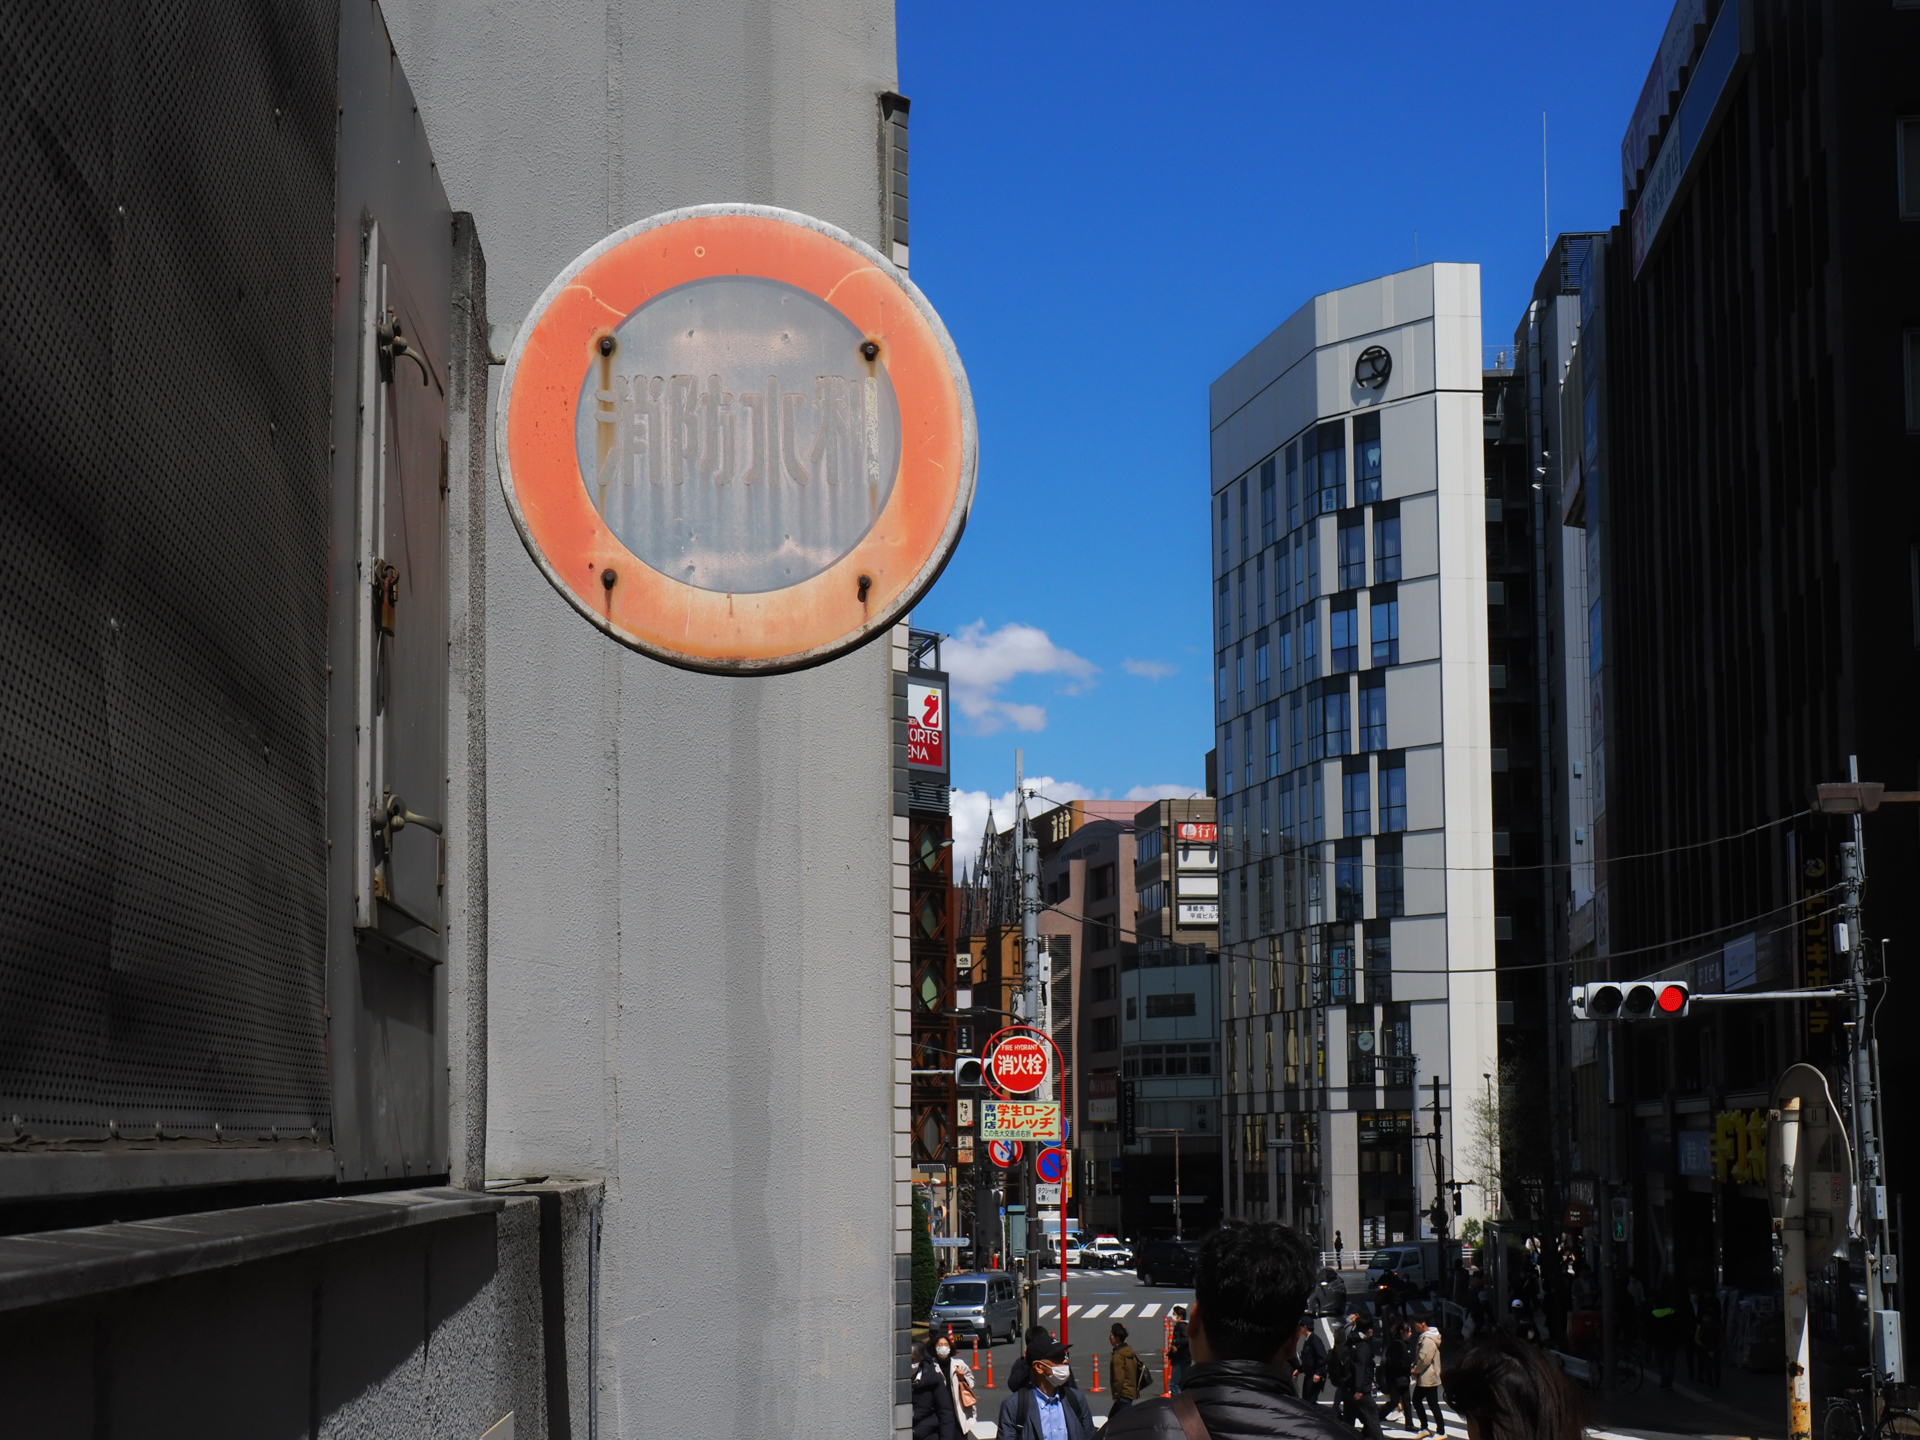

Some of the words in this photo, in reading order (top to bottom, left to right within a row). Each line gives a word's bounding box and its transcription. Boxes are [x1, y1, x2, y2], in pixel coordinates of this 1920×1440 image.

[596, 375, 879, 485] 消防水利
[998, 1054, 1043, 1075] 消火栓
[985, 1104, 996, 1129] 専門店
[997, 1104, 1056, 1117] 学生ローン
[984, 1130, 1031, 1138] この先大交差点右折
